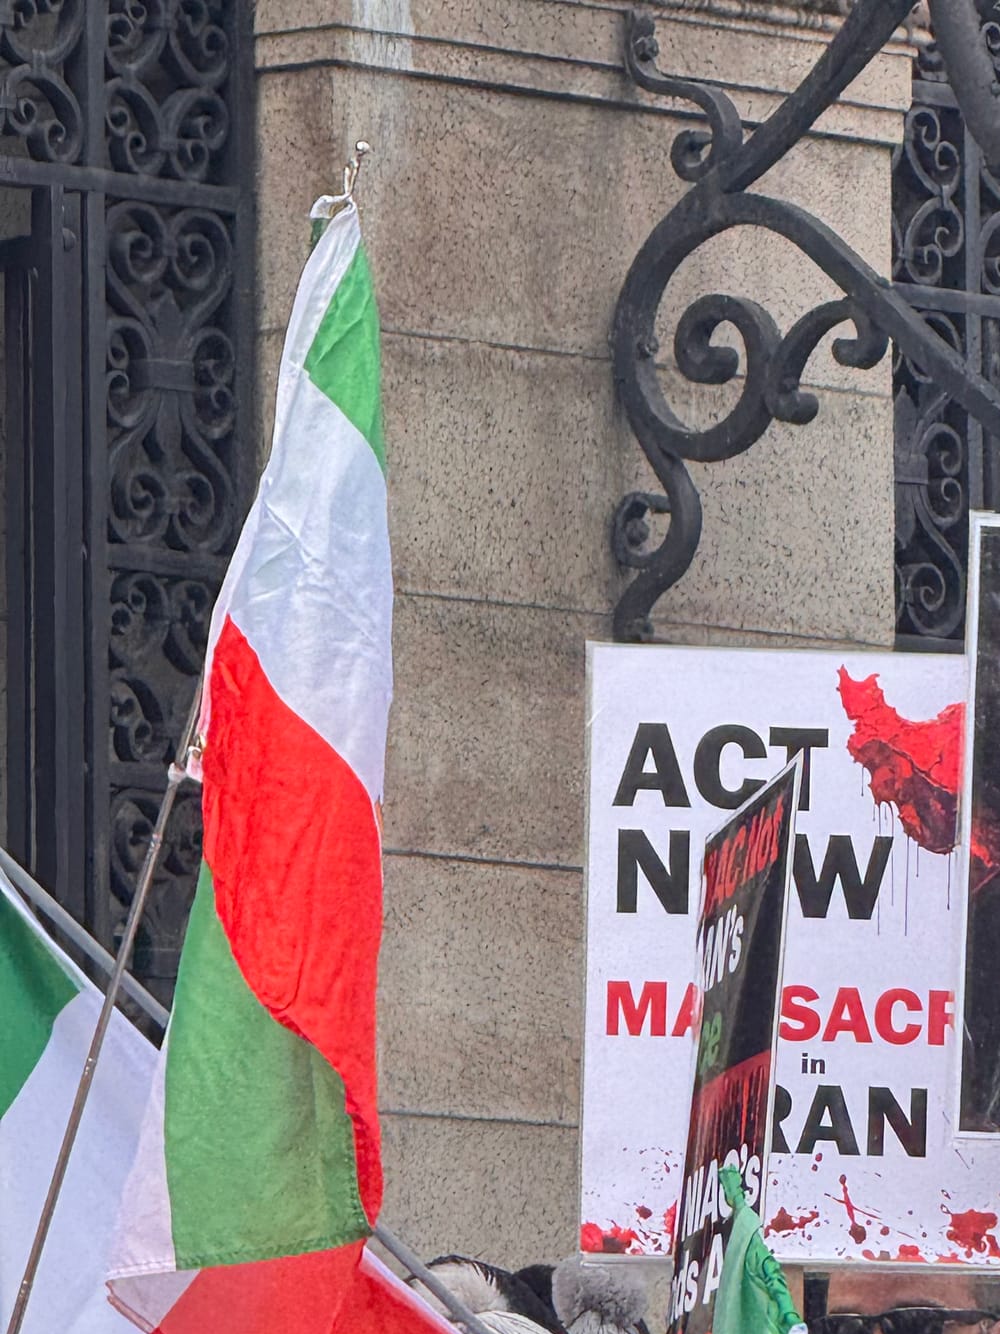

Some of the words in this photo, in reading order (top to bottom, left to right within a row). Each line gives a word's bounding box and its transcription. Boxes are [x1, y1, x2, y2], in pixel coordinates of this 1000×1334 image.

[611, 722, 829, 811] ACT
[616, 828, 894, 920] NW
[802, 1053, 826, 1075] in
[771, 1085, 928, 1158] RAN
